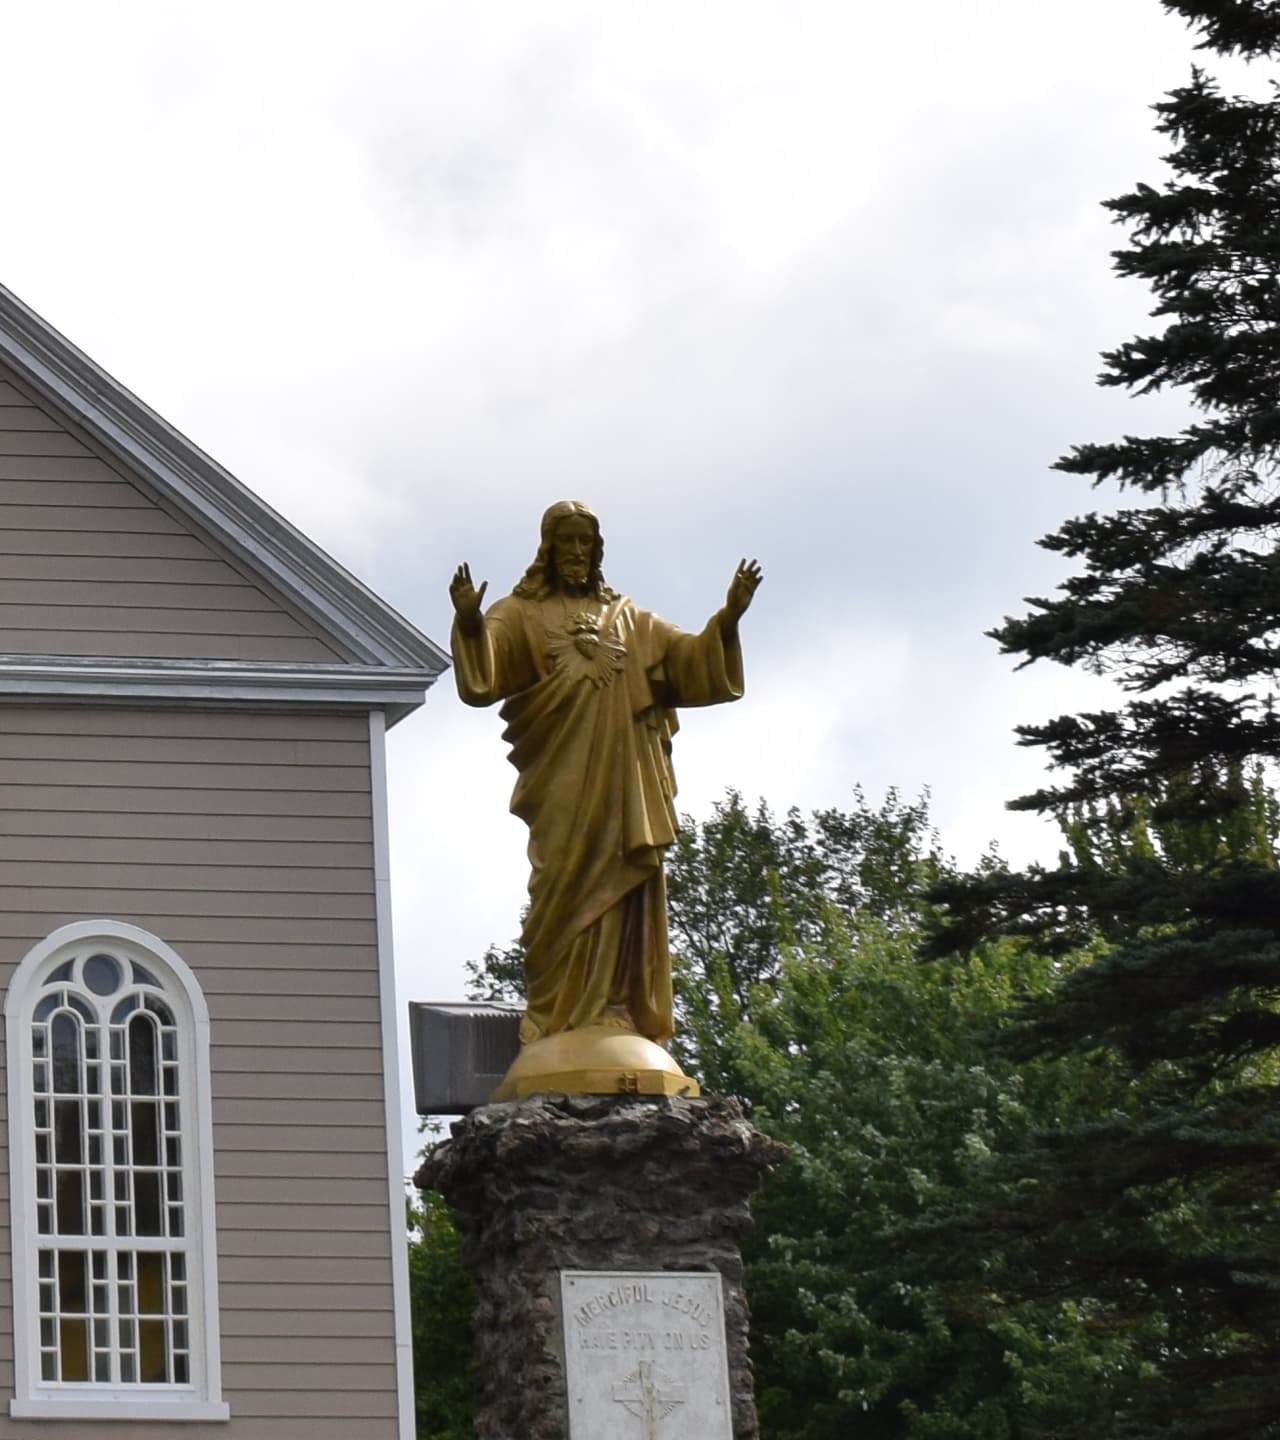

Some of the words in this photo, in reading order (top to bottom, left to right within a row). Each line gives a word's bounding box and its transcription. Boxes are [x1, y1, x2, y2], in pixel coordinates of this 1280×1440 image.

[573, 1283, 653, 1327] MERCIFUL
[662, 1291, 713, 1328] JESUS
[578, 1330, 617, 1351] HAVE
[623, 1330, 655, 1351] PITY
[663, 1330, 684, 1351] ON
[690, 1331, 711, 1351] US
